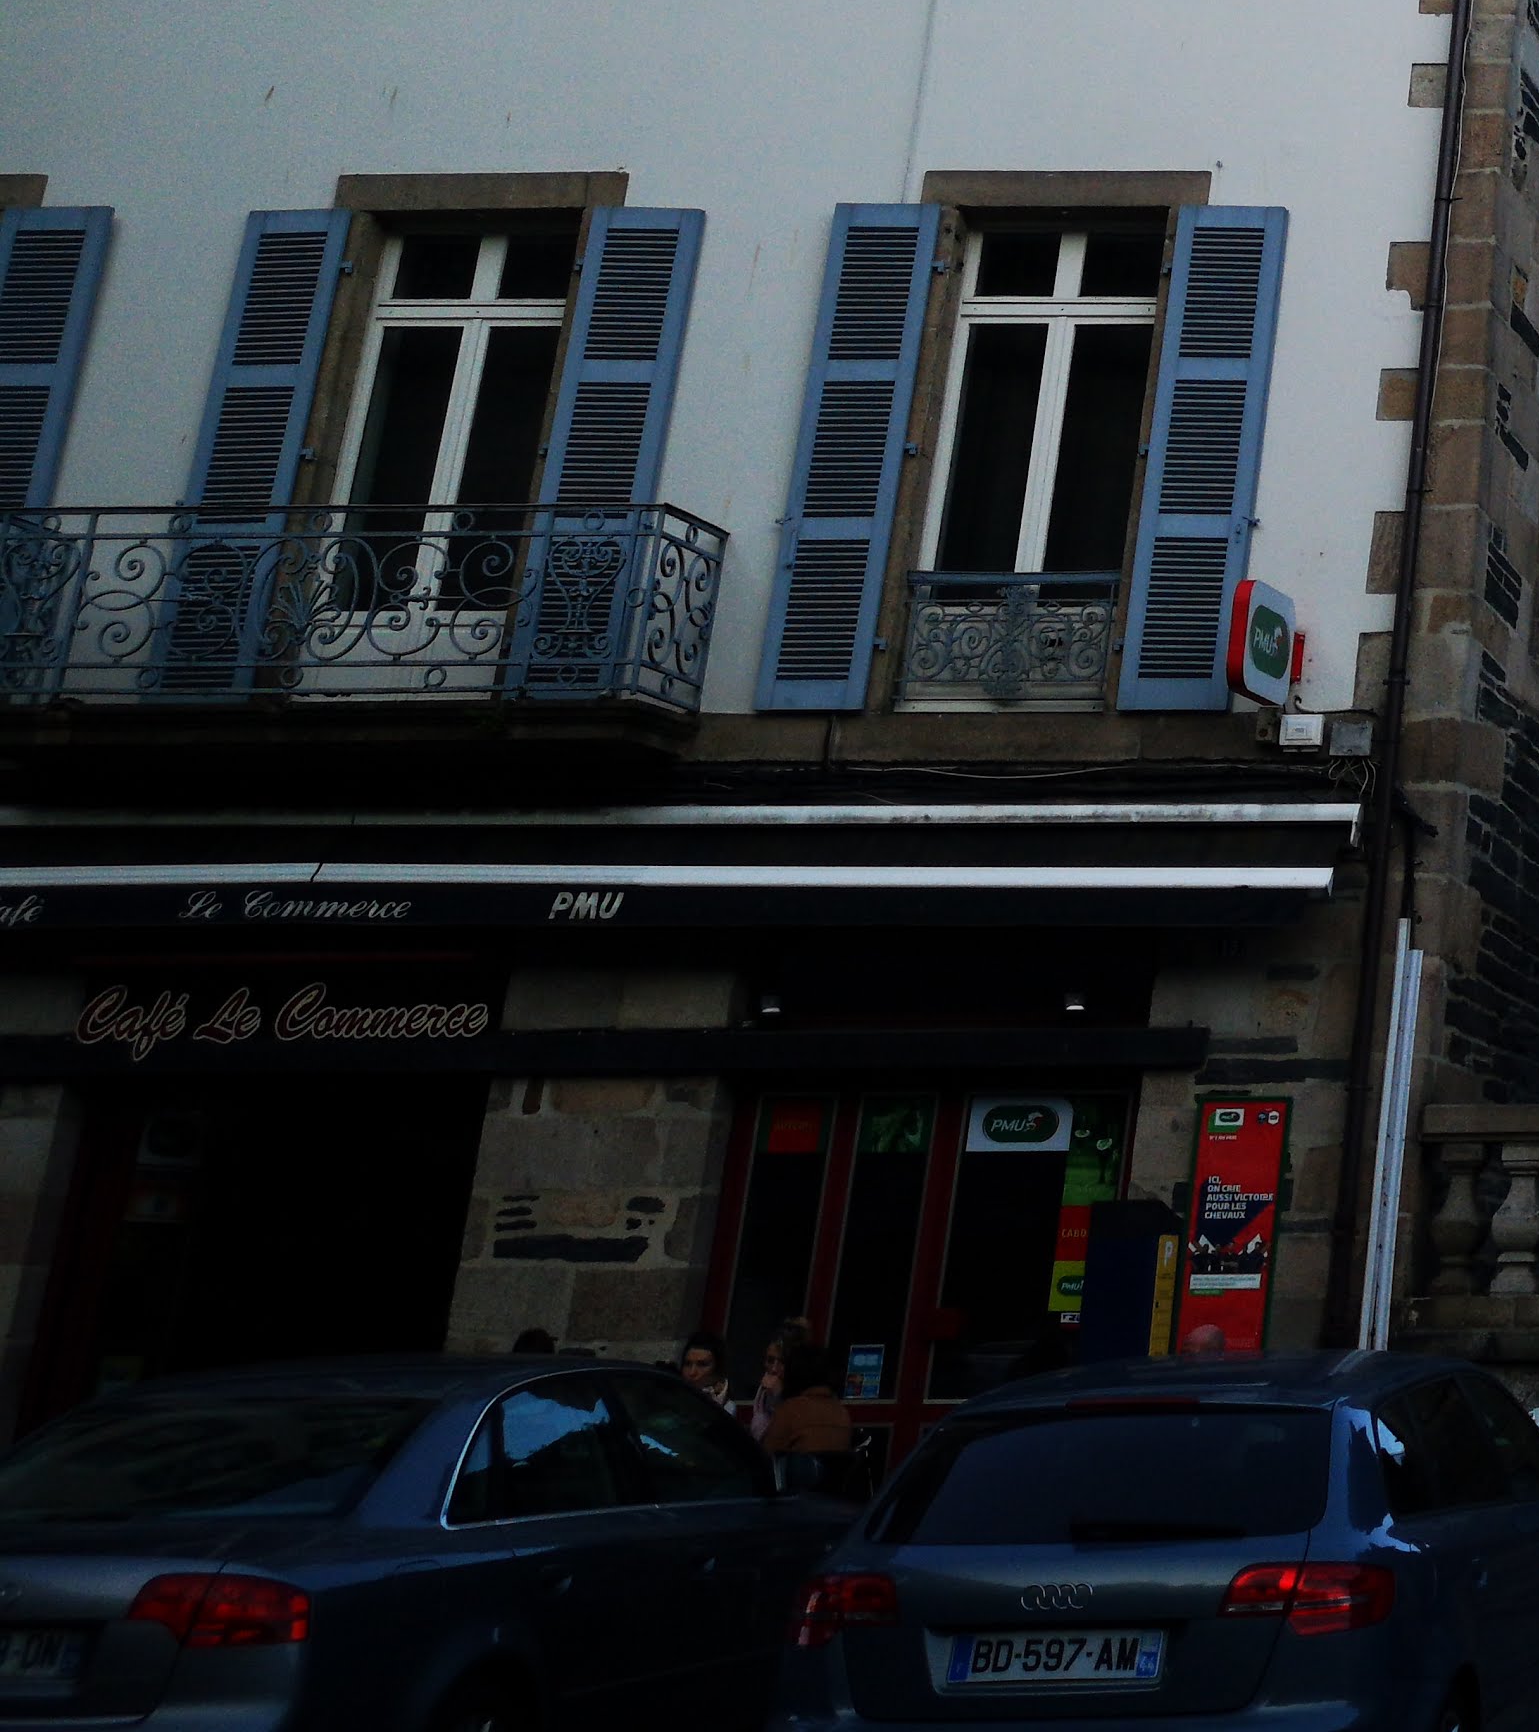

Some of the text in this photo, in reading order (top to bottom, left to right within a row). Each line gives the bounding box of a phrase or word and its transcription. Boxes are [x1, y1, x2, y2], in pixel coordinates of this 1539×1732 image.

[1253, 626, 1274, 654] PMU
[0, 890, 625, 928] afé Le Commerce PMU
[76, 982, 489, 1061] Café Le Commerce
[991, 1118, 1027, 1133] PMU
[1207, 1184, 1242, 1193] ON CRIE
[1206, 1193, 1274, 1202] AUSSI VICTOIRE
[1205, 1202, 1247, 1211] POUR LES
[1204, 1211, 1247, 1220] CHEVAUX
[970, 1637, 1140, 1674] BD-597-AM
